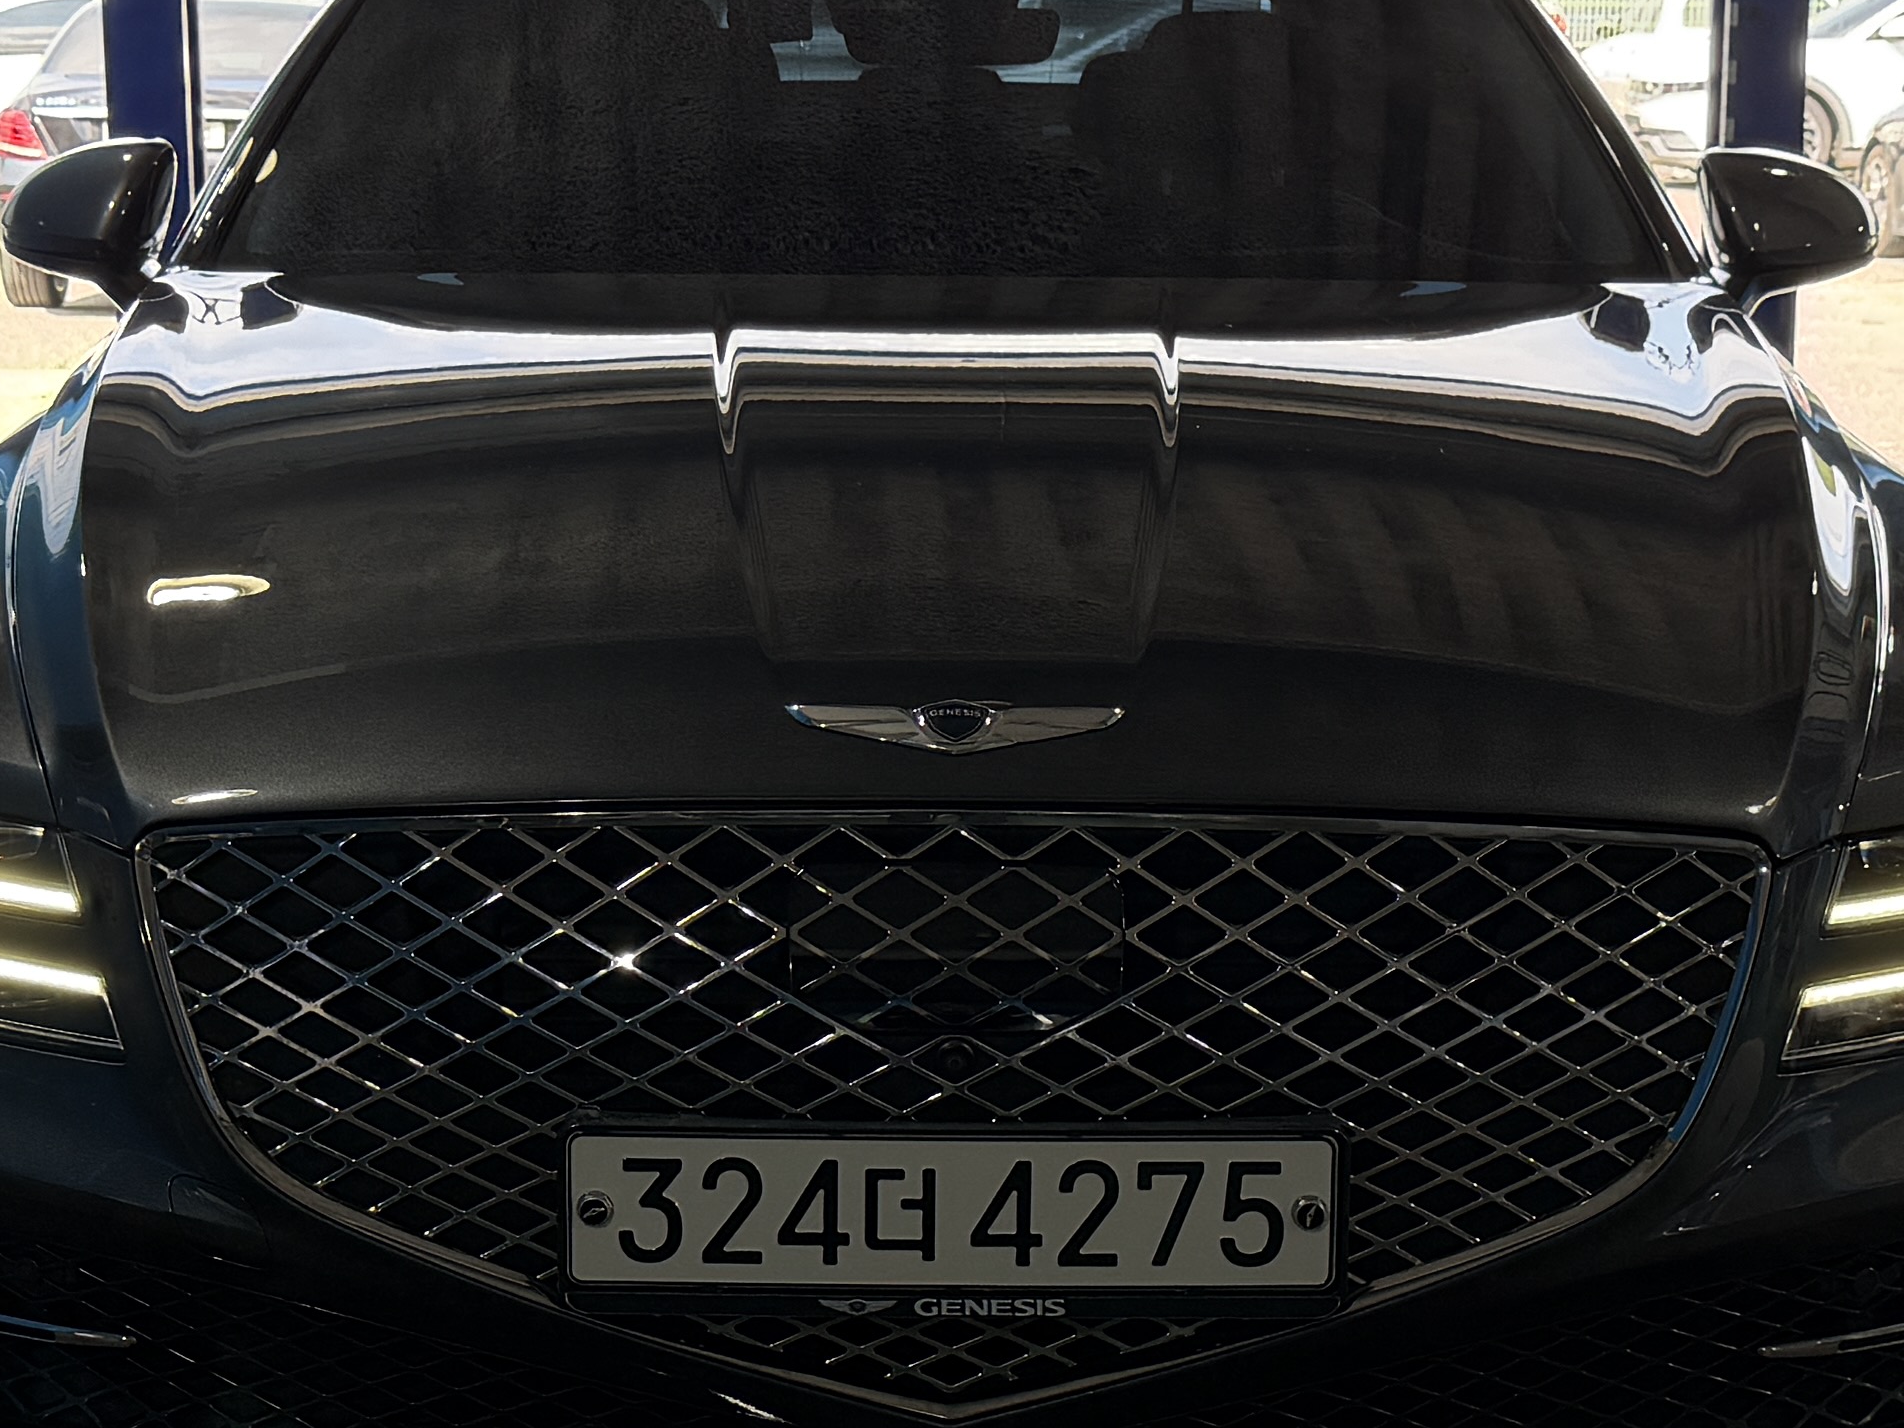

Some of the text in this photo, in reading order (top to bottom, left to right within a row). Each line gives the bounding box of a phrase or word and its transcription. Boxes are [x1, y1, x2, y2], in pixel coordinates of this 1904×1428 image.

[928, 708, 982, 718] GENESIS
[617, 1157, 1285, 1268] 324더 4275
[913, 1297, 1067, 1318] GENESIS
